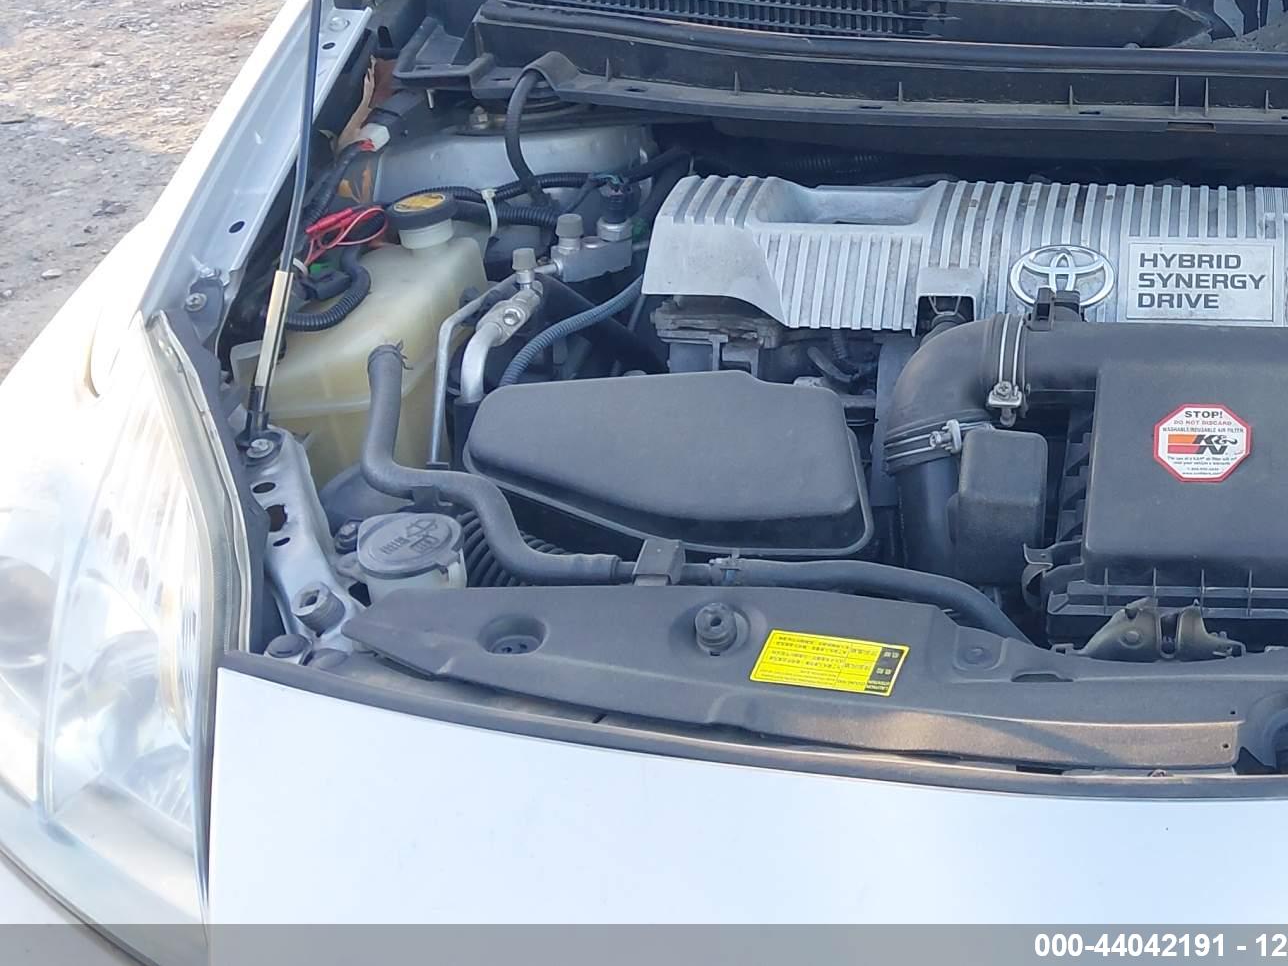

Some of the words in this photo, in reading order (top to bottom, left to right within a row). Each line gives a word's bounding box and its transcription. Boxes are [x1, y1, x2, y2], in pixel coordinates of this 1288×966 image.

[1139, 253, 1242, 269] HYBRID
[1138, 273, 1266, 290] SYNERGY
[1137, 293, 1220, 309] DRIVE
[1184, 410, 1223, 419] STOP!
